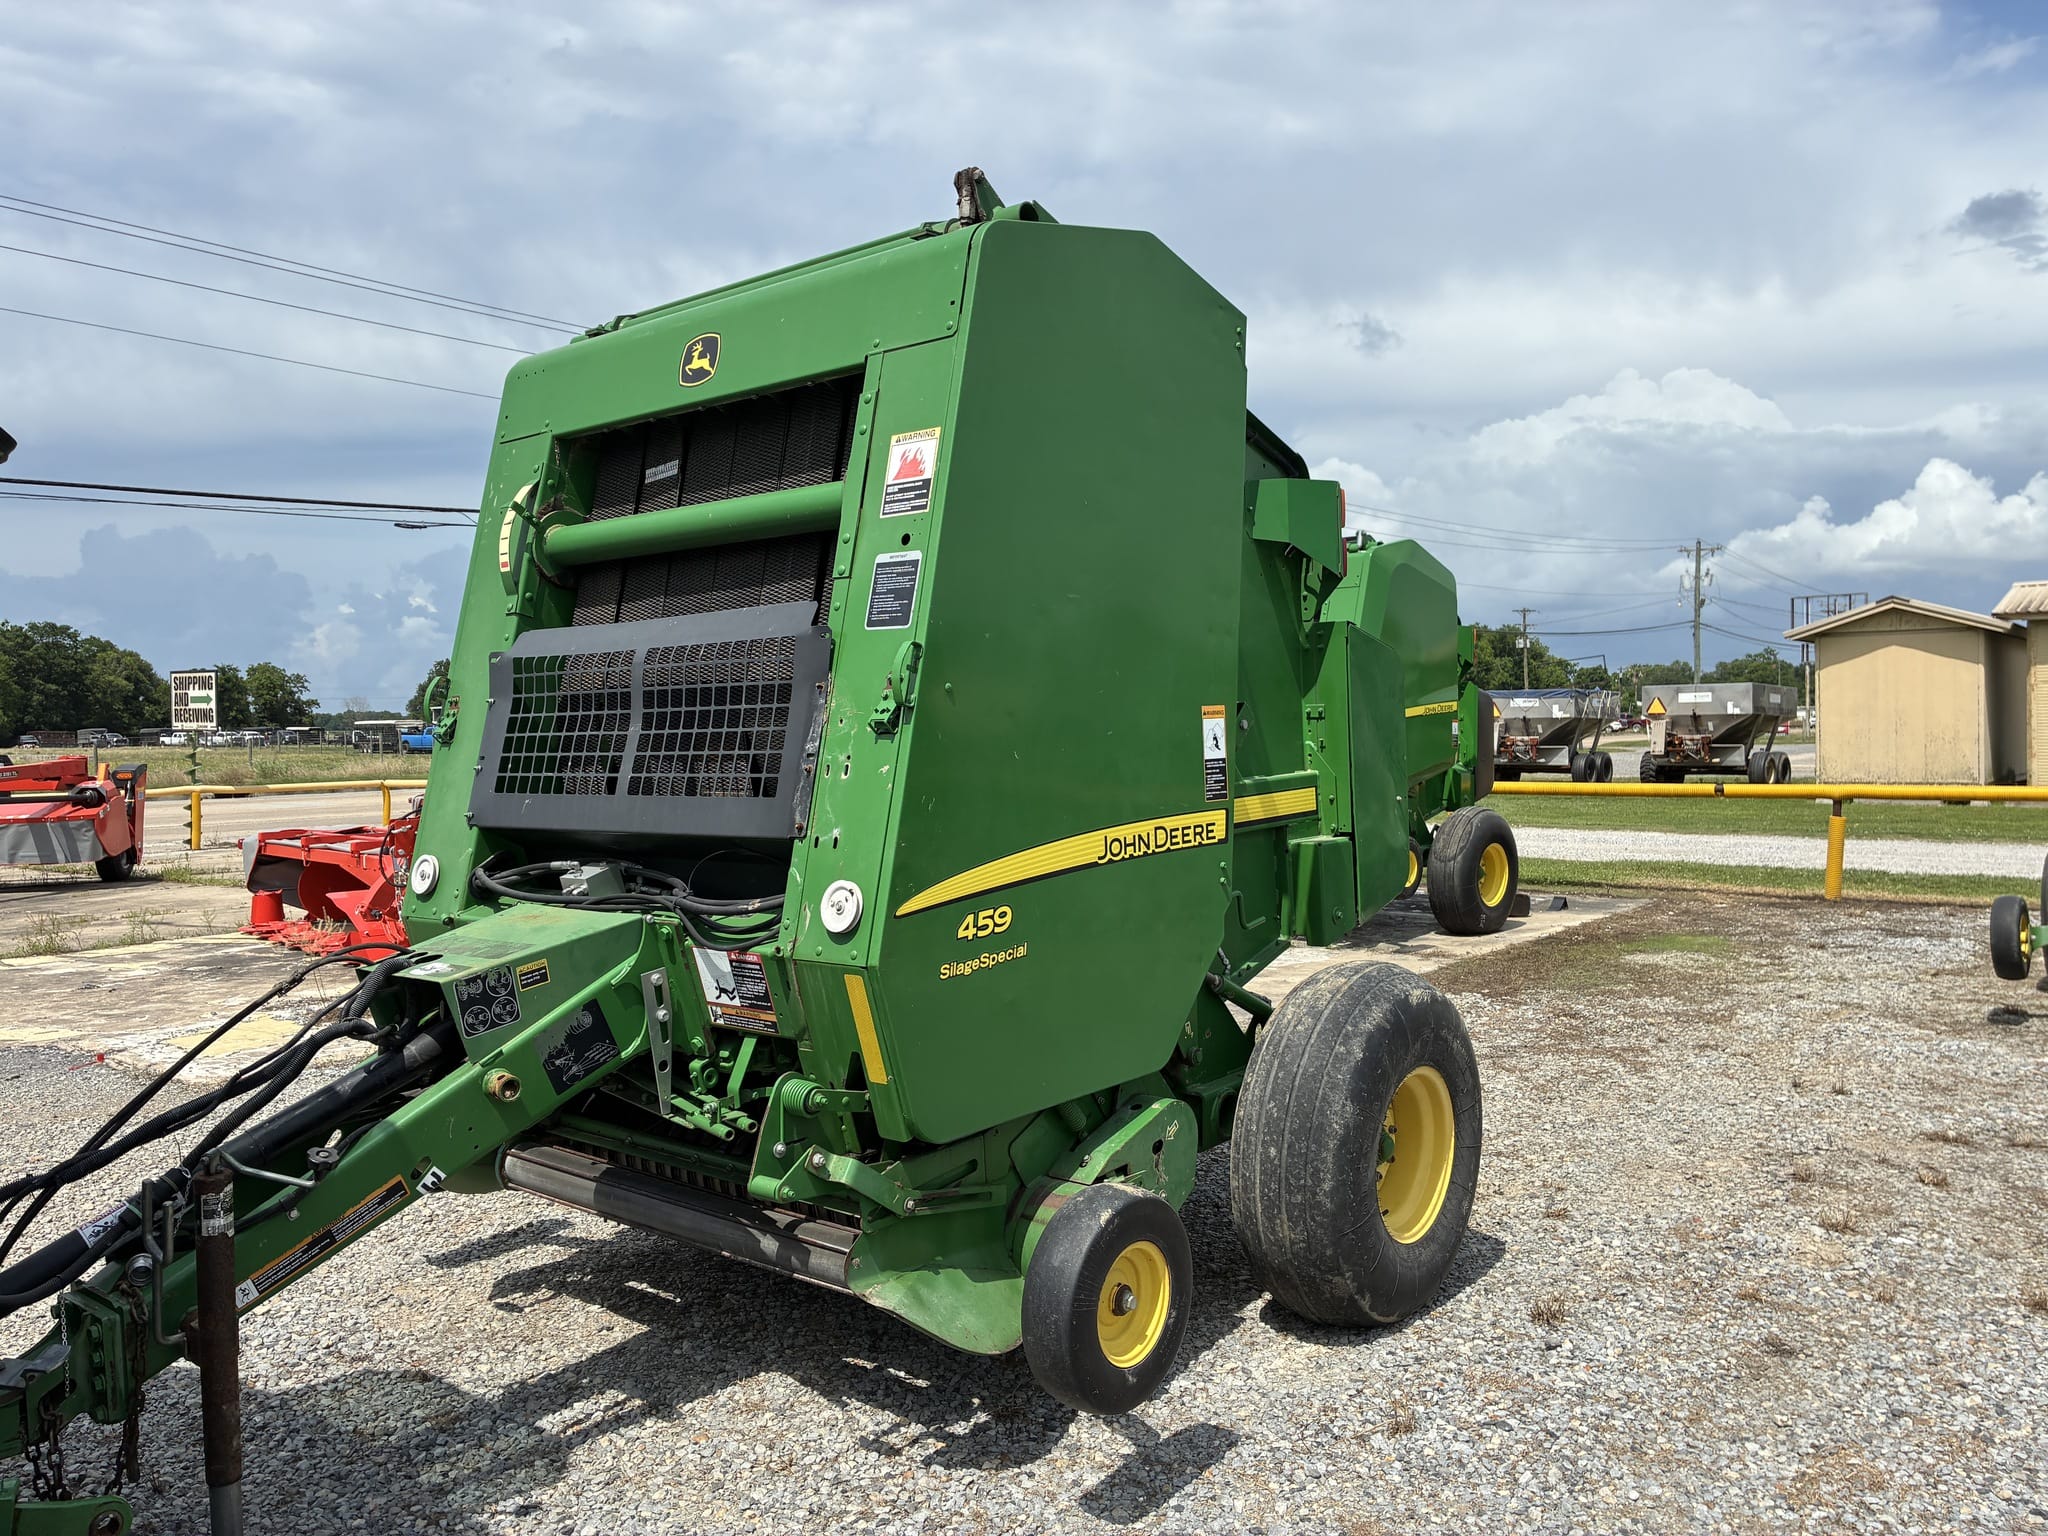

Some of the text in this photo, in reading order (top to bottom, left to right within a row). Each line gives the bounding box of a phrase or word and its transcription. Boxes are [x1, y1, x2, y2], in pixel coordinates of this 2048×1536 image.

[901, 429, 936, 443] WARNING
[173, 675, 213, 691] SHIPPING
[174, 692, 189, 707] AND
[174, 708, 214, 723] RECEIVING
[1423, 704, 1454, 715] JOHN DEERE
[1097, 822, 1217, 861] JOHN DEERE
[957, 904, 1013, 941] 459
[939, 941, 1028, 980] SilageSpecial
